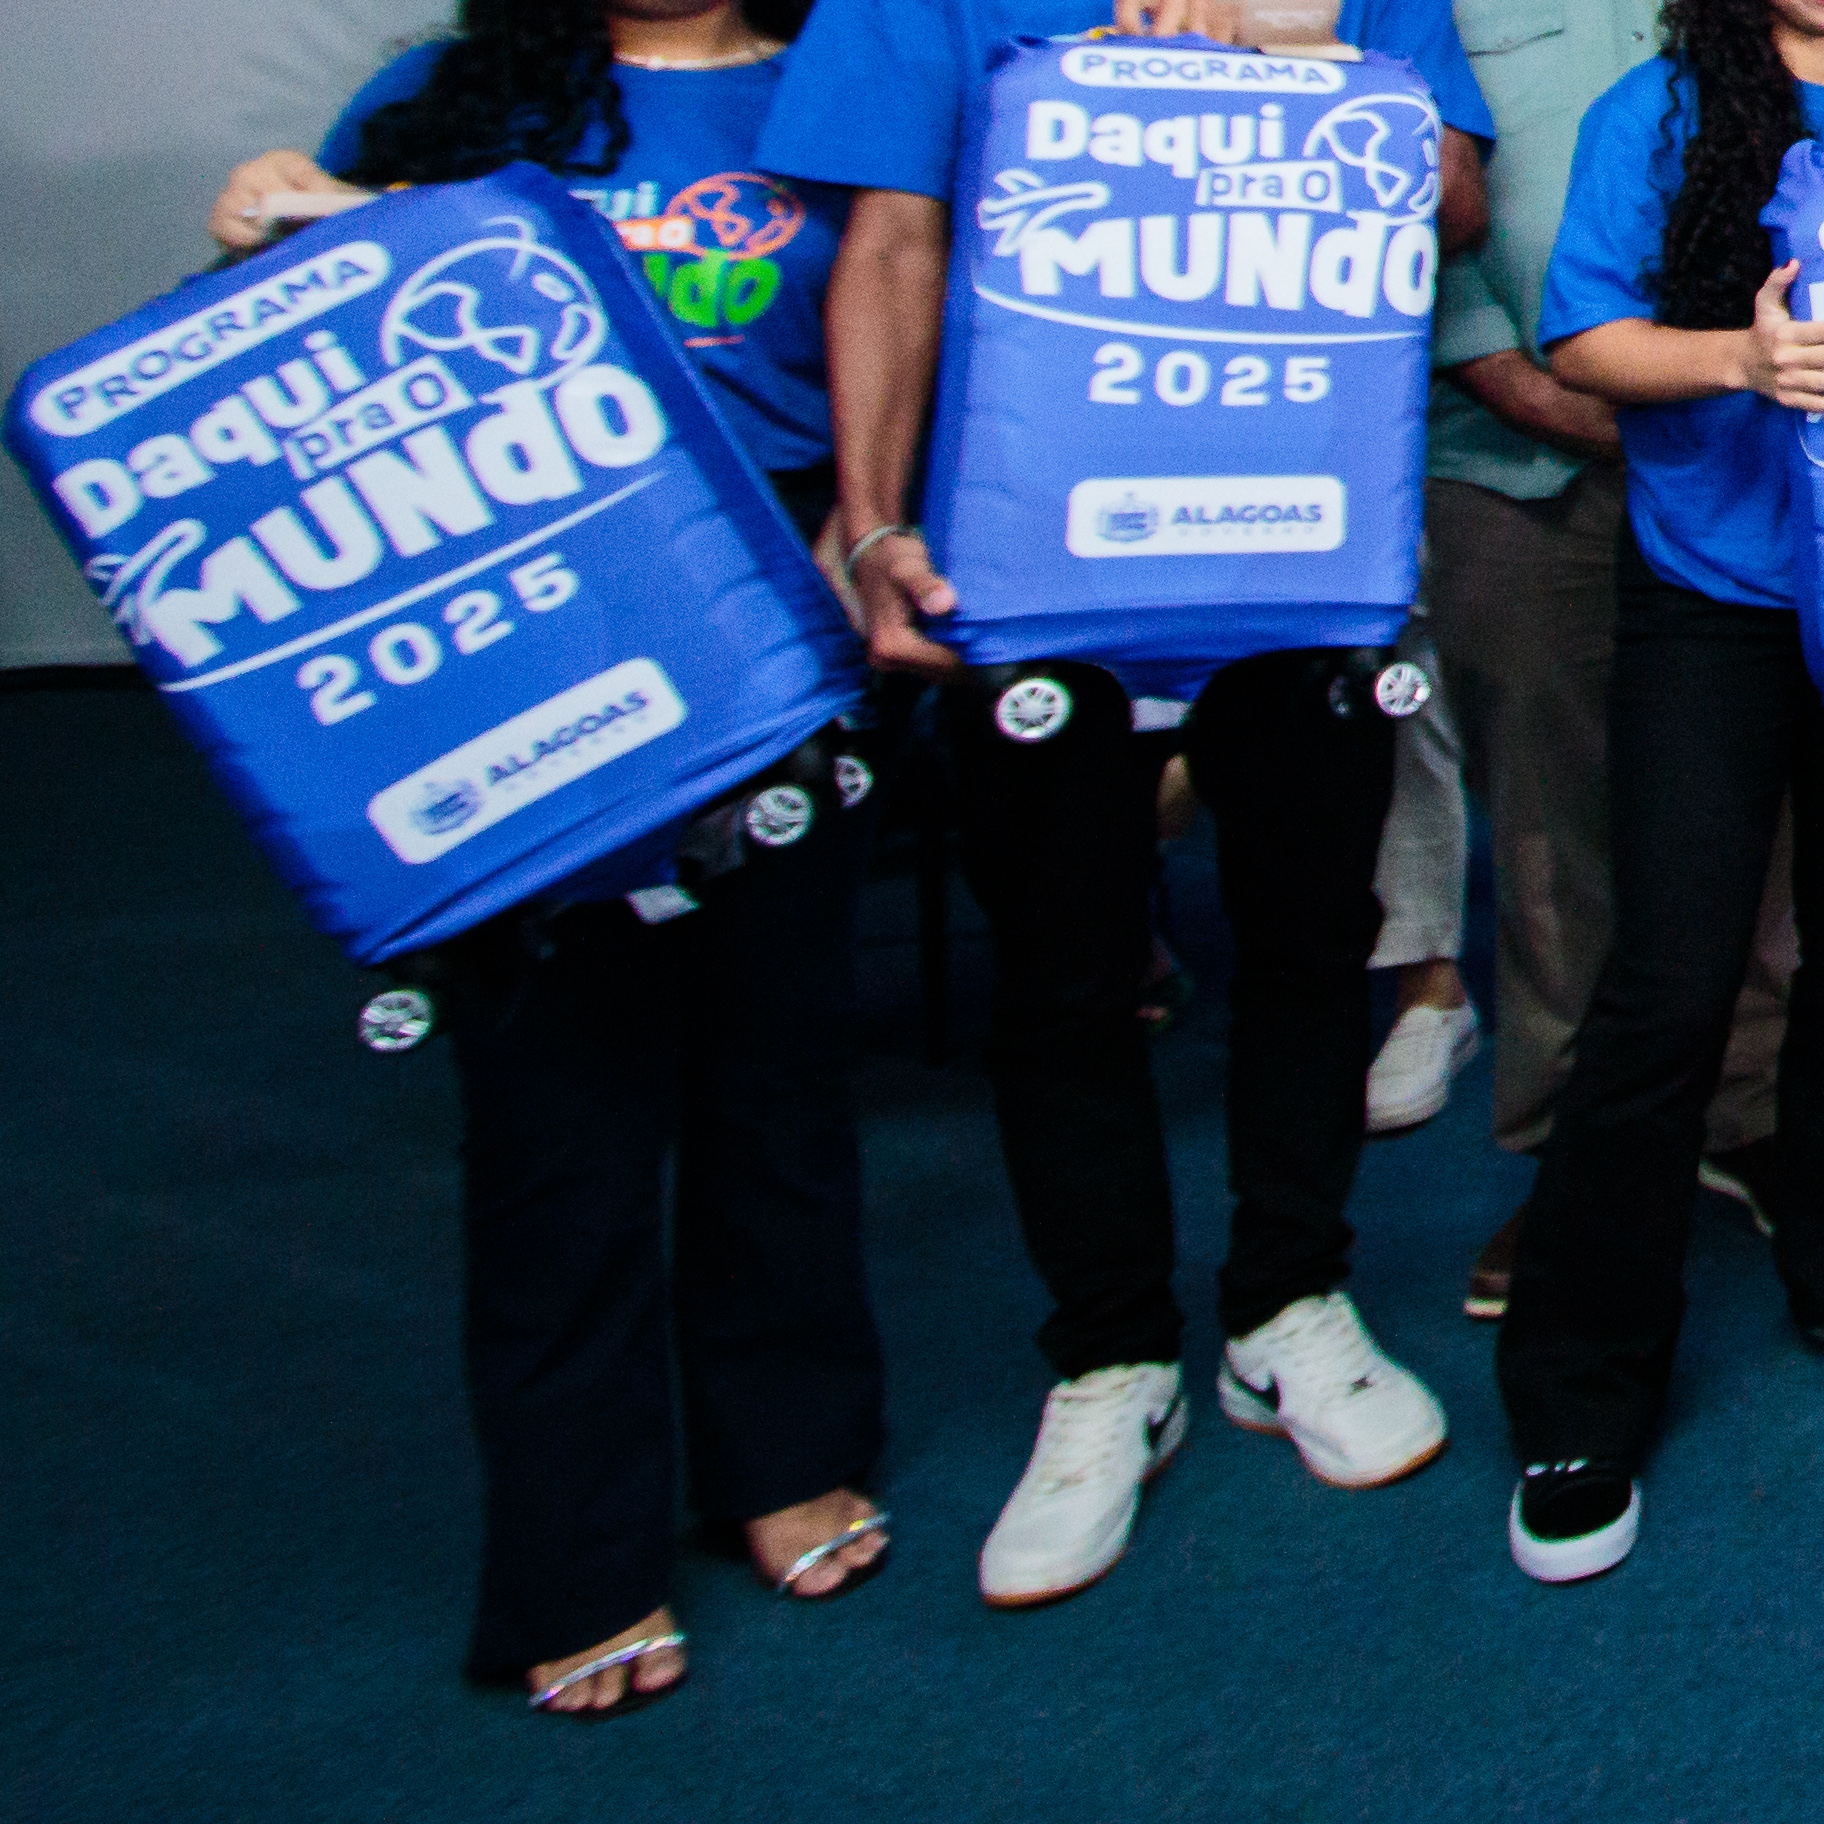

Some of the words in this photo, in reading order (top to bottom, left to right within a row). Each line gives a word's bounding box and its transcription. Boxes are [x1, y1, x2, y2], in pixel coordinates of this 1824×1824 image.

[1081, 54, 1331, 86] PROGRAMA
[1206, 173, 1286, 206] pra
[52, 260, 371, 420] PROGRAMA
[1089, 342, 1332, 407] 2025
[295, 402, 398, 475] pra
[1171, 504, 1323, 525] ALAGOAS
[297, 552, 581, 727] 2025
[485, 692, 650, 786] ALAGOAS
